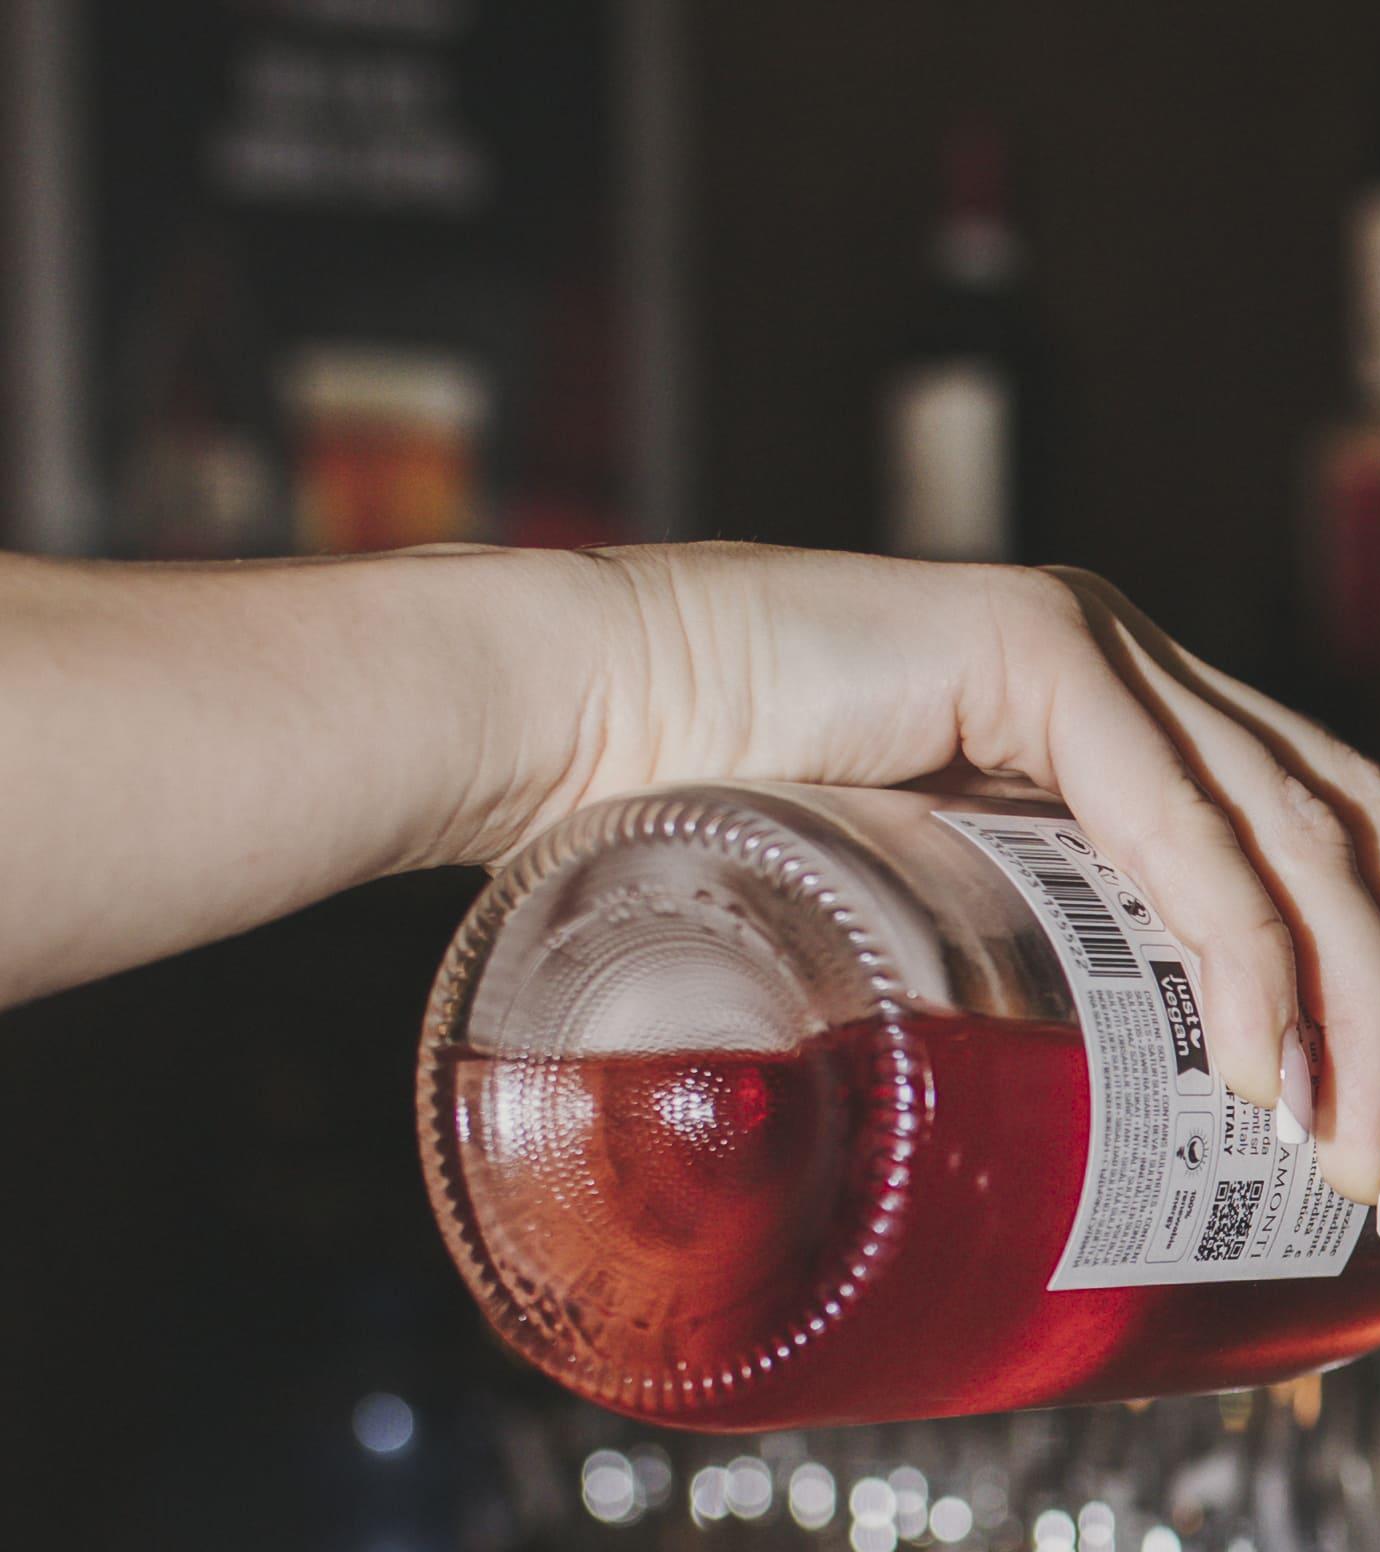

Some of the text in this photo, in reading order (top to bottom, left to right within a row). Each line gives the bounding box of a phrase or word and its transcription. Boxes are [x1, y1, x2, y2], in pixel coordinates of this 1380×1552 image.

[1143, 990, 1162, 1039] CONTIENE
[1160, 976, 1189, 1056] vegan
[1169, 973, 1199, 1026] just
[1157, 1045, 1168, 1085] SOLFITI
[1161, 1094, 1170, 1148] CONTAINS
[1223, 1105, 1235, 1155] ITALY
[1236, 1121, 1249, 1155] Italy
[1262, 1108, 1271, 1155] ine da
[1166, 1190, 1188, 1250] renewable
[1184, 1190, 1197, 1219] 100%
[1251, 1147, 1290, 1258] AMONTI
